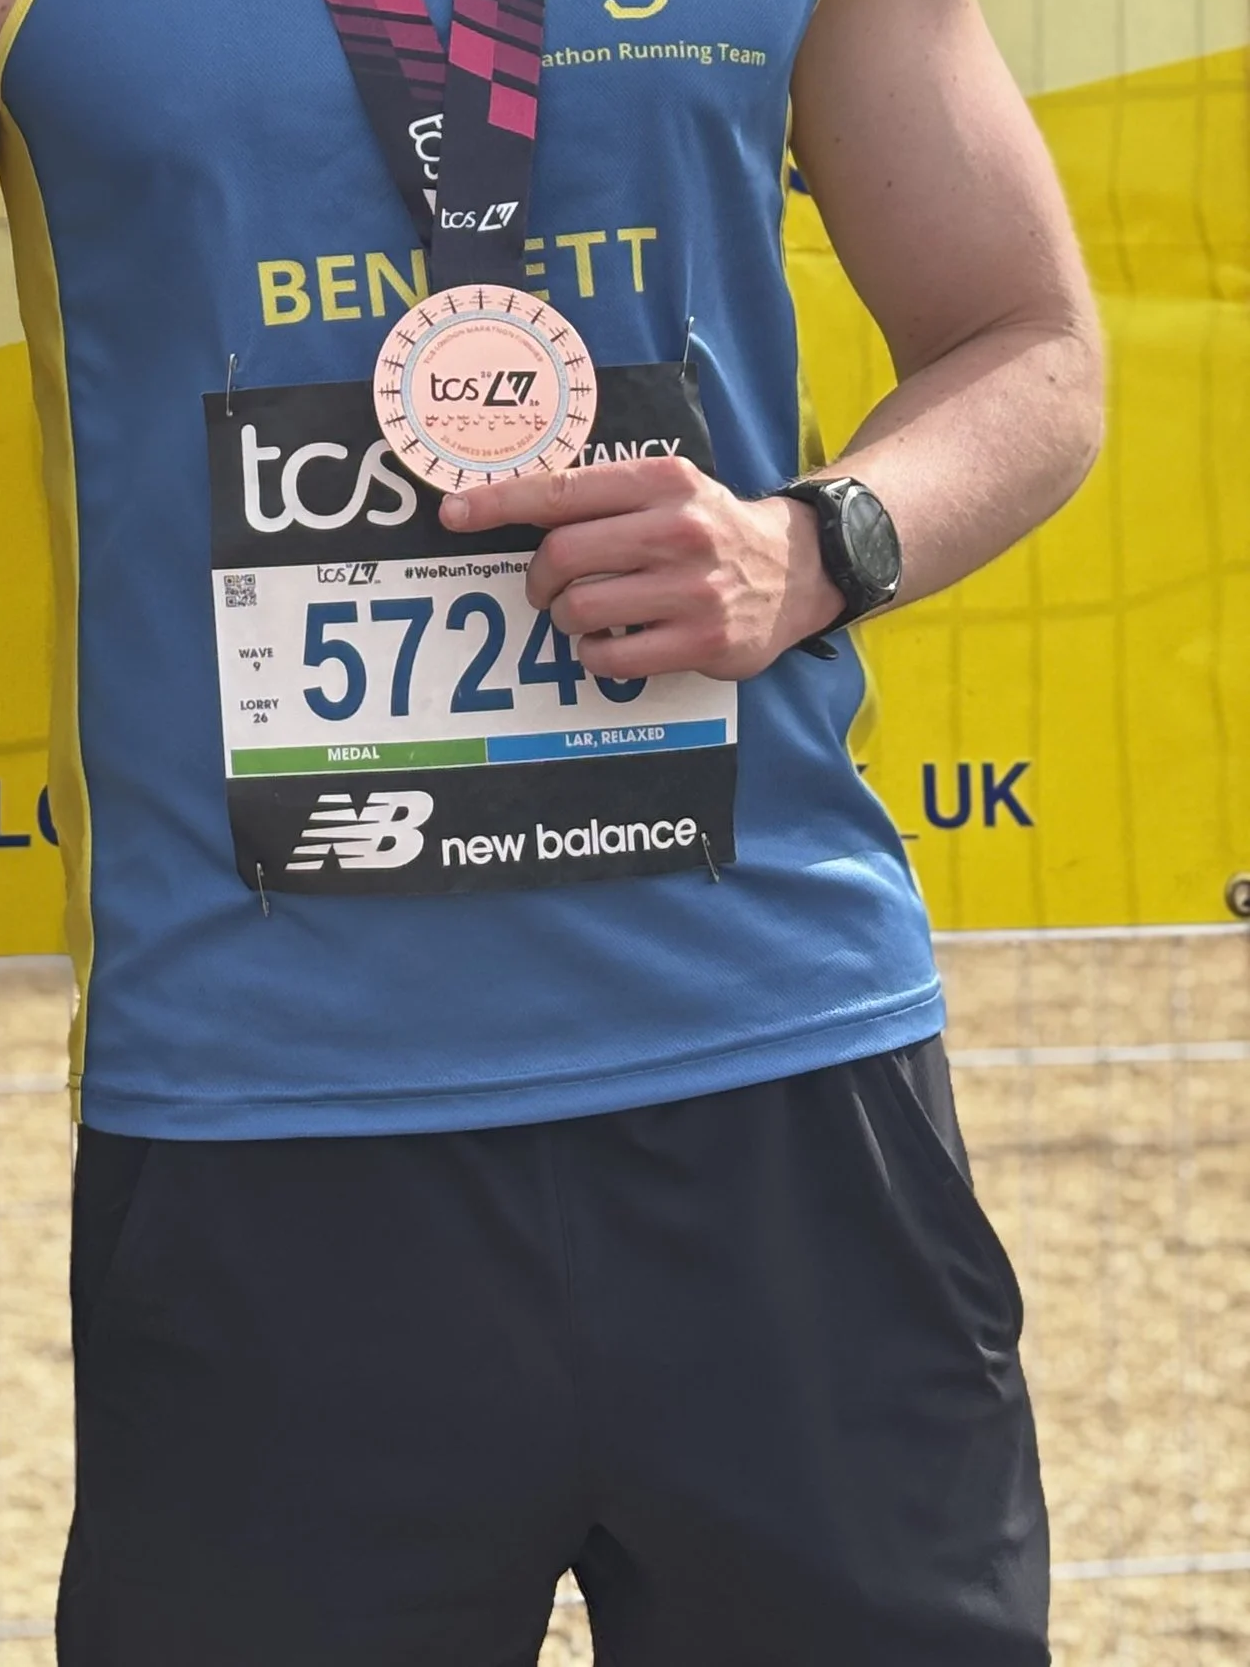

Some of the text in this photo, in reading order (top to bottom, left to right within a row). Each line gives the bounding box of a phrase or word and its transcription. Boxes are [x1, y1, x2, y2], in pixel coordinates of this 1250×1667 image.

[541, 40, 766, 67] athon Running Team
[441, 208, 477, 229] tcs
[257, 227, 657, 326] BENETT
[430, 372, 479, 402] tcs
[241, 424, 418, 533] tcs
[404, 560, 529, 580] #WeRunTogether
[238, 646, 274, 659] WAVE
[252, 661, 261, 672] 9
[239, 698, 279, 711] LORRY
[252, 712, 269, 724] 26
[565, 726, 666, 750] LAR, RELAXED
[327, 746, 380, 762] MEDAL
[900, 762, 1035, 840] UK
[441, 831, 526, 866] new
[536, 815, 698, 860] balance
